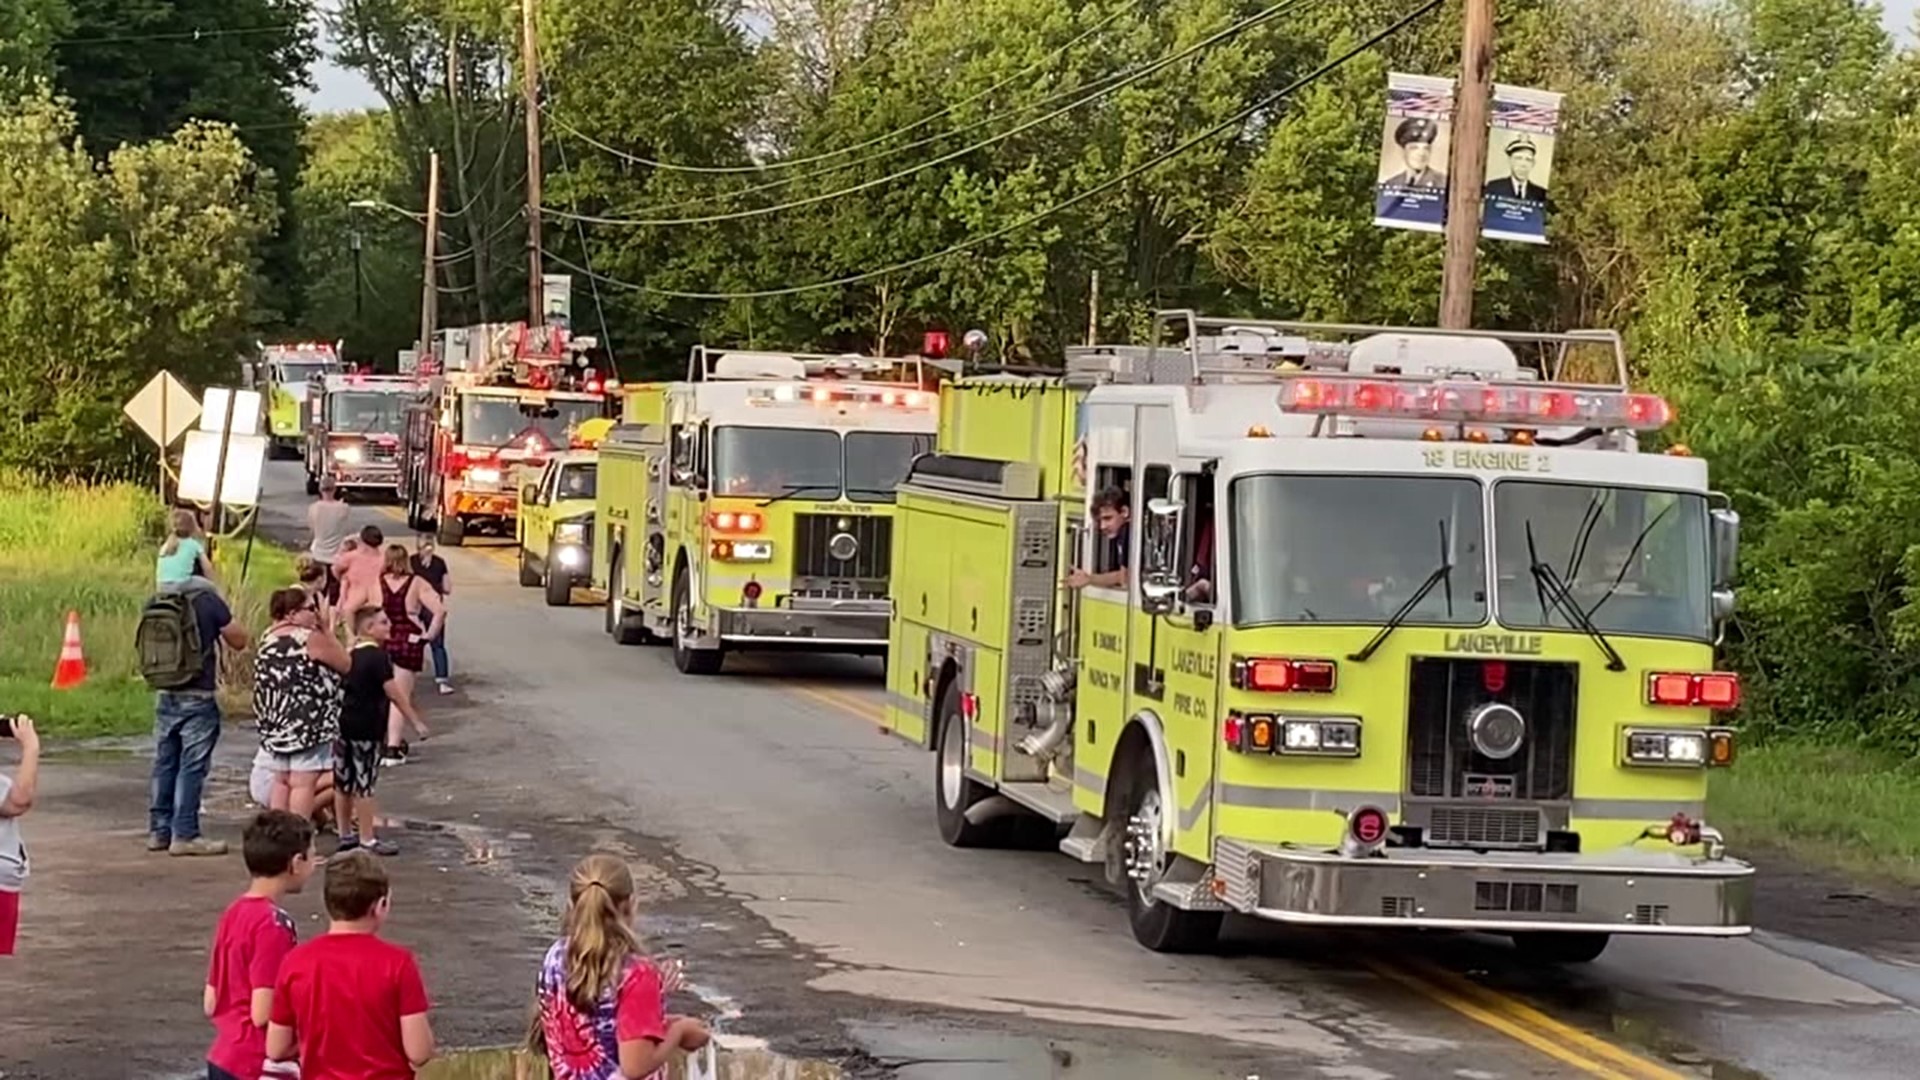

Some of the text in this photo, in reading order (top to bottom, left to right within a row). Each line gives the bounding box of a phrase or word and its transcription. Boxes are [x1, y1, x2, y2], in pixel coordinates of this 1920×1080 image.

[1453, 449, 1530, 471] ENGINE
[1537, 455, 1551, 472] 2
[1444, 632, 1542, 655] LAKEVILLE
[1171, 646, 1214, 680] LAKEVILLE
[1174, 692, 1191, 715] FIRE
